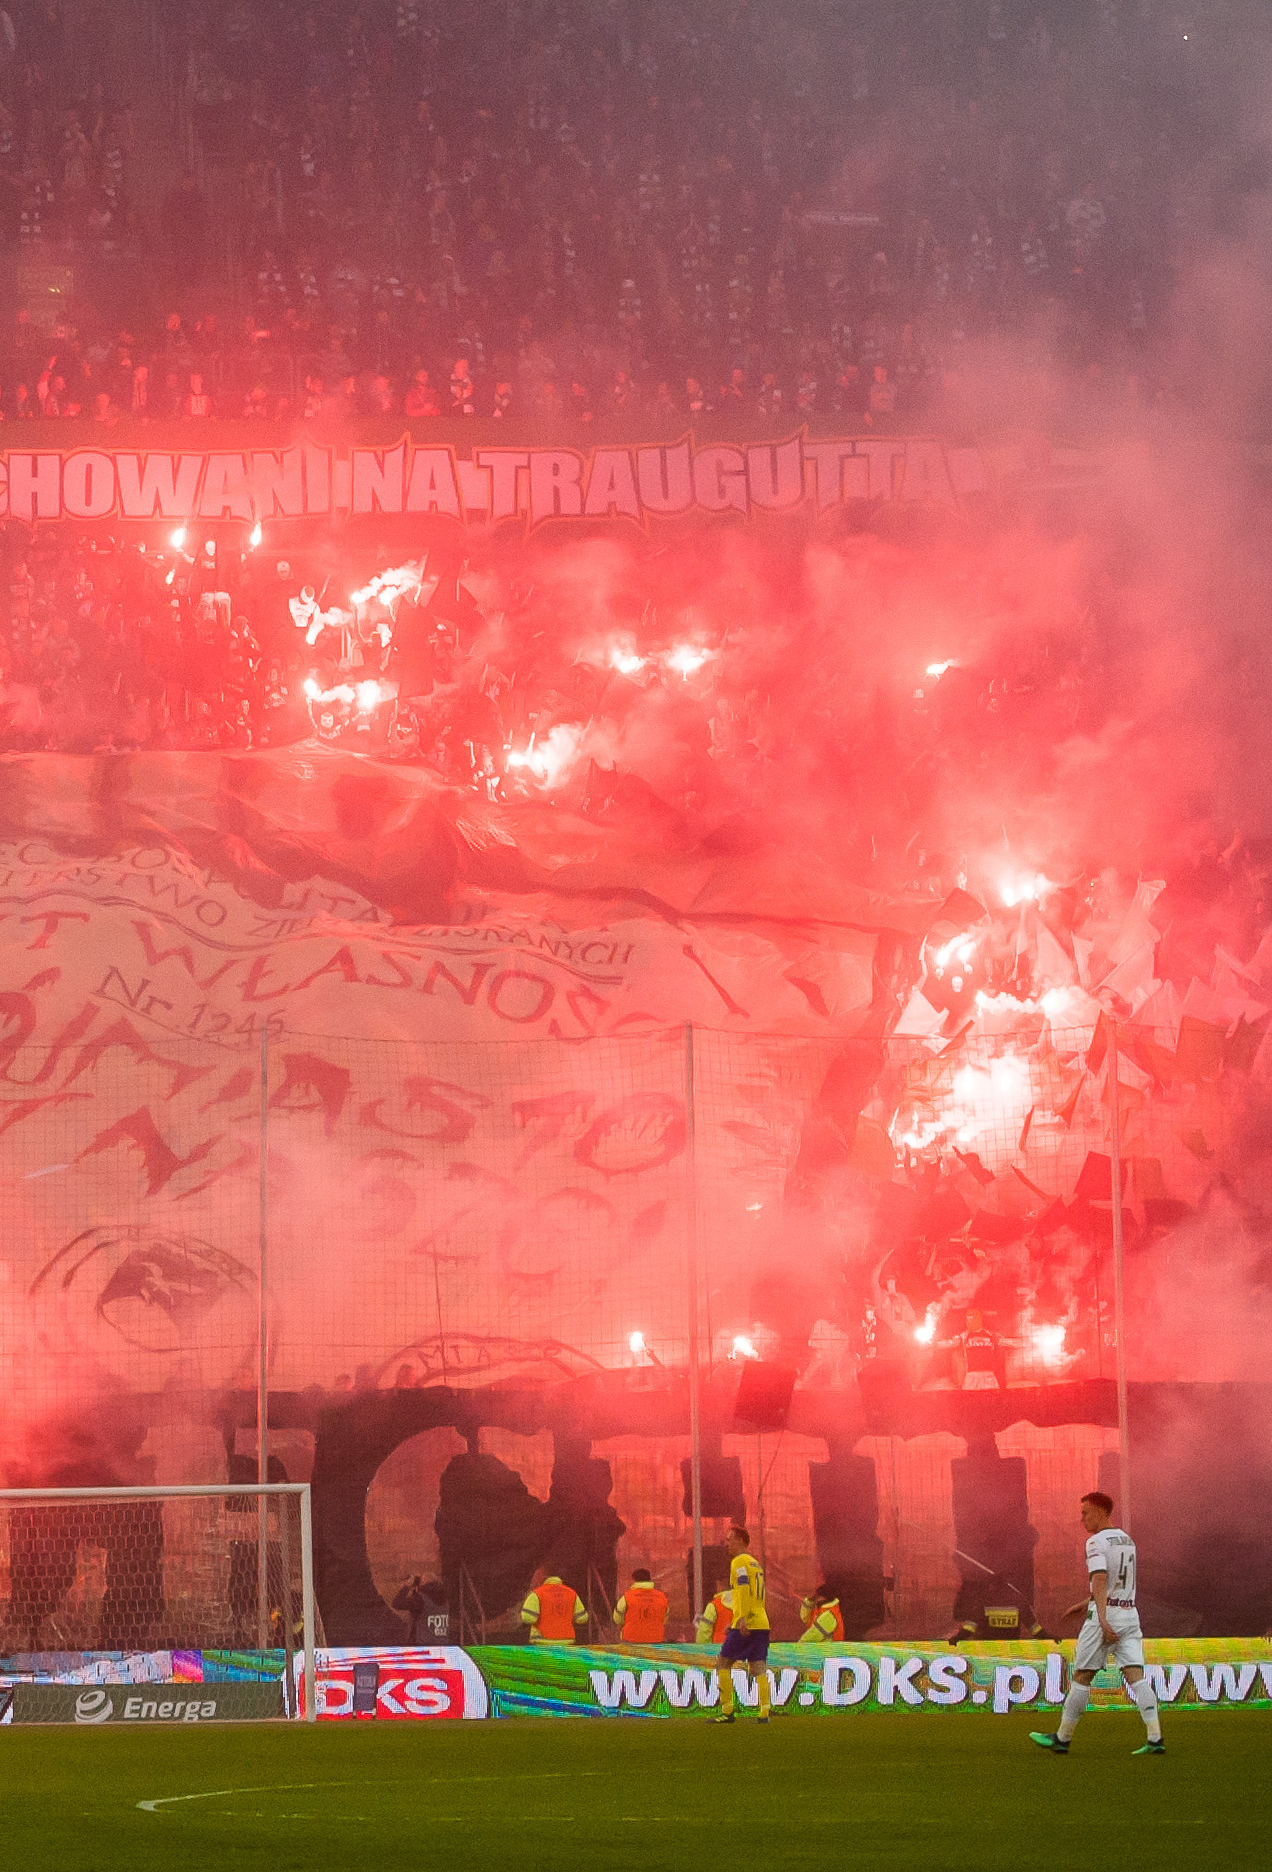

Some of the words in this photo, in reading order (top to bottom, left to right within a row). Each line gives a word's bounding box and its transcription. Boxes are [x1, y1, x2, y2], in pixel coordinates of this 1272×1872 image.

[351, 430, 459, 516] NA
[95, 965, 173, 1012] Nr
[124, 1697, 217, 1721] Energa
[589, 1653, 1067, 1714] www.DKS.pl
